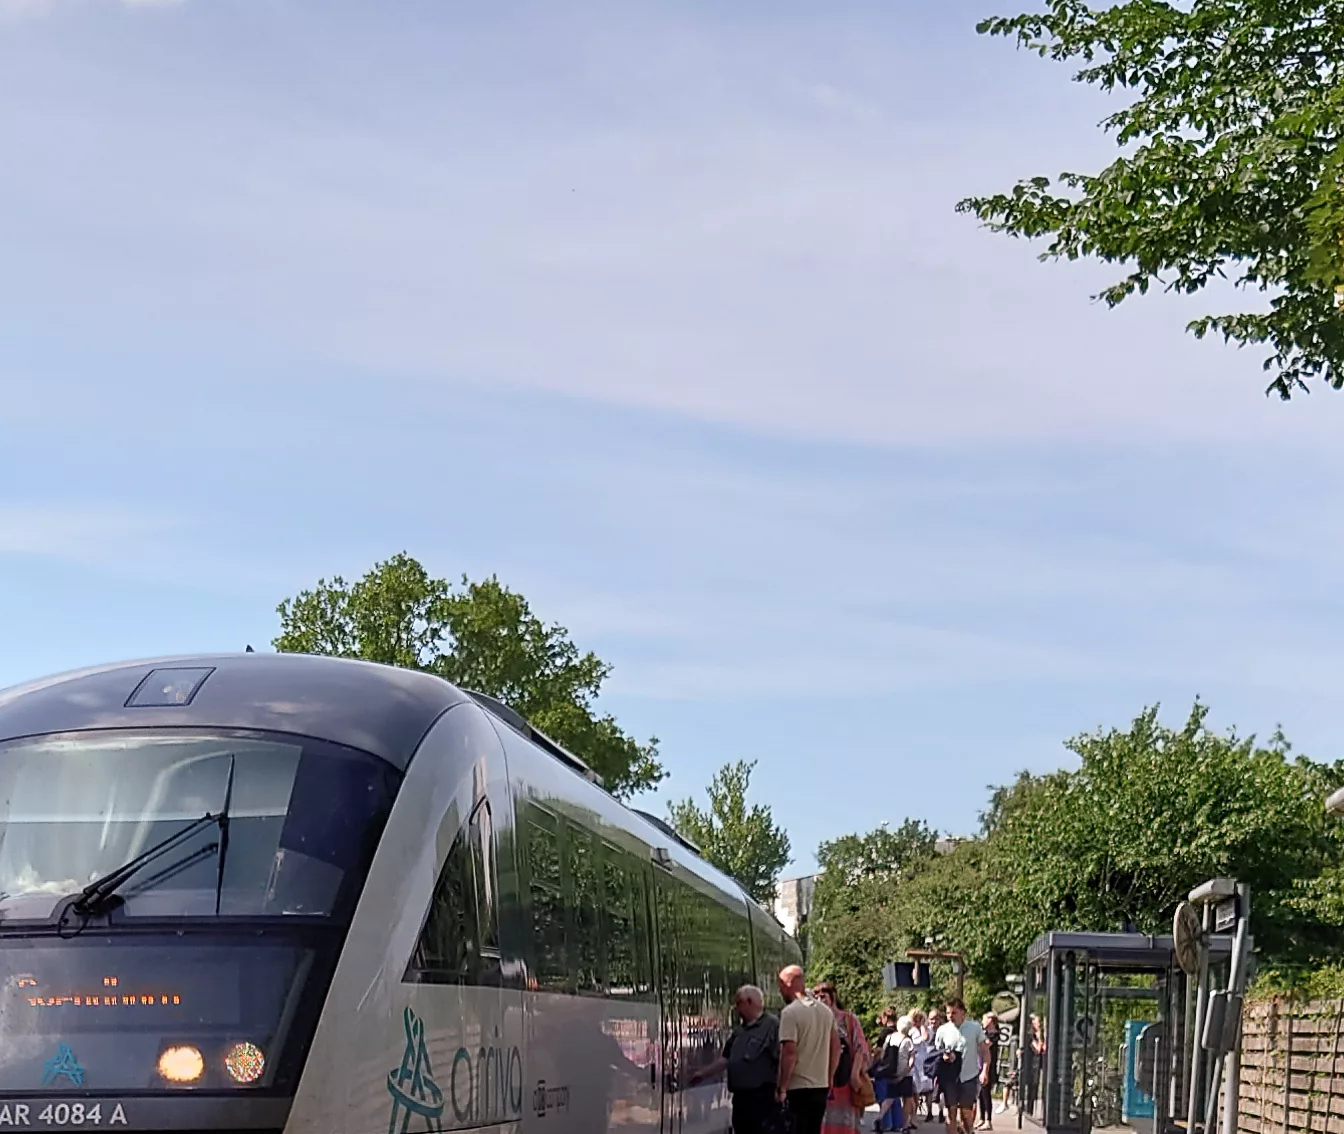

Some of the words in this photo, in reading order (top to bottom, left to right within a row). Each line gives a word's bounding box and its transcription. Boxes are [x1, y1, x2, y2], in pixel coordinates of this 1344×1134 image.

[999, 1026, 1010, 1042] S
[451, 1024, 522, 1123] arriva
[38, 1103, 102, 1125] 4084
[109, 1103, 128, 1125] A
